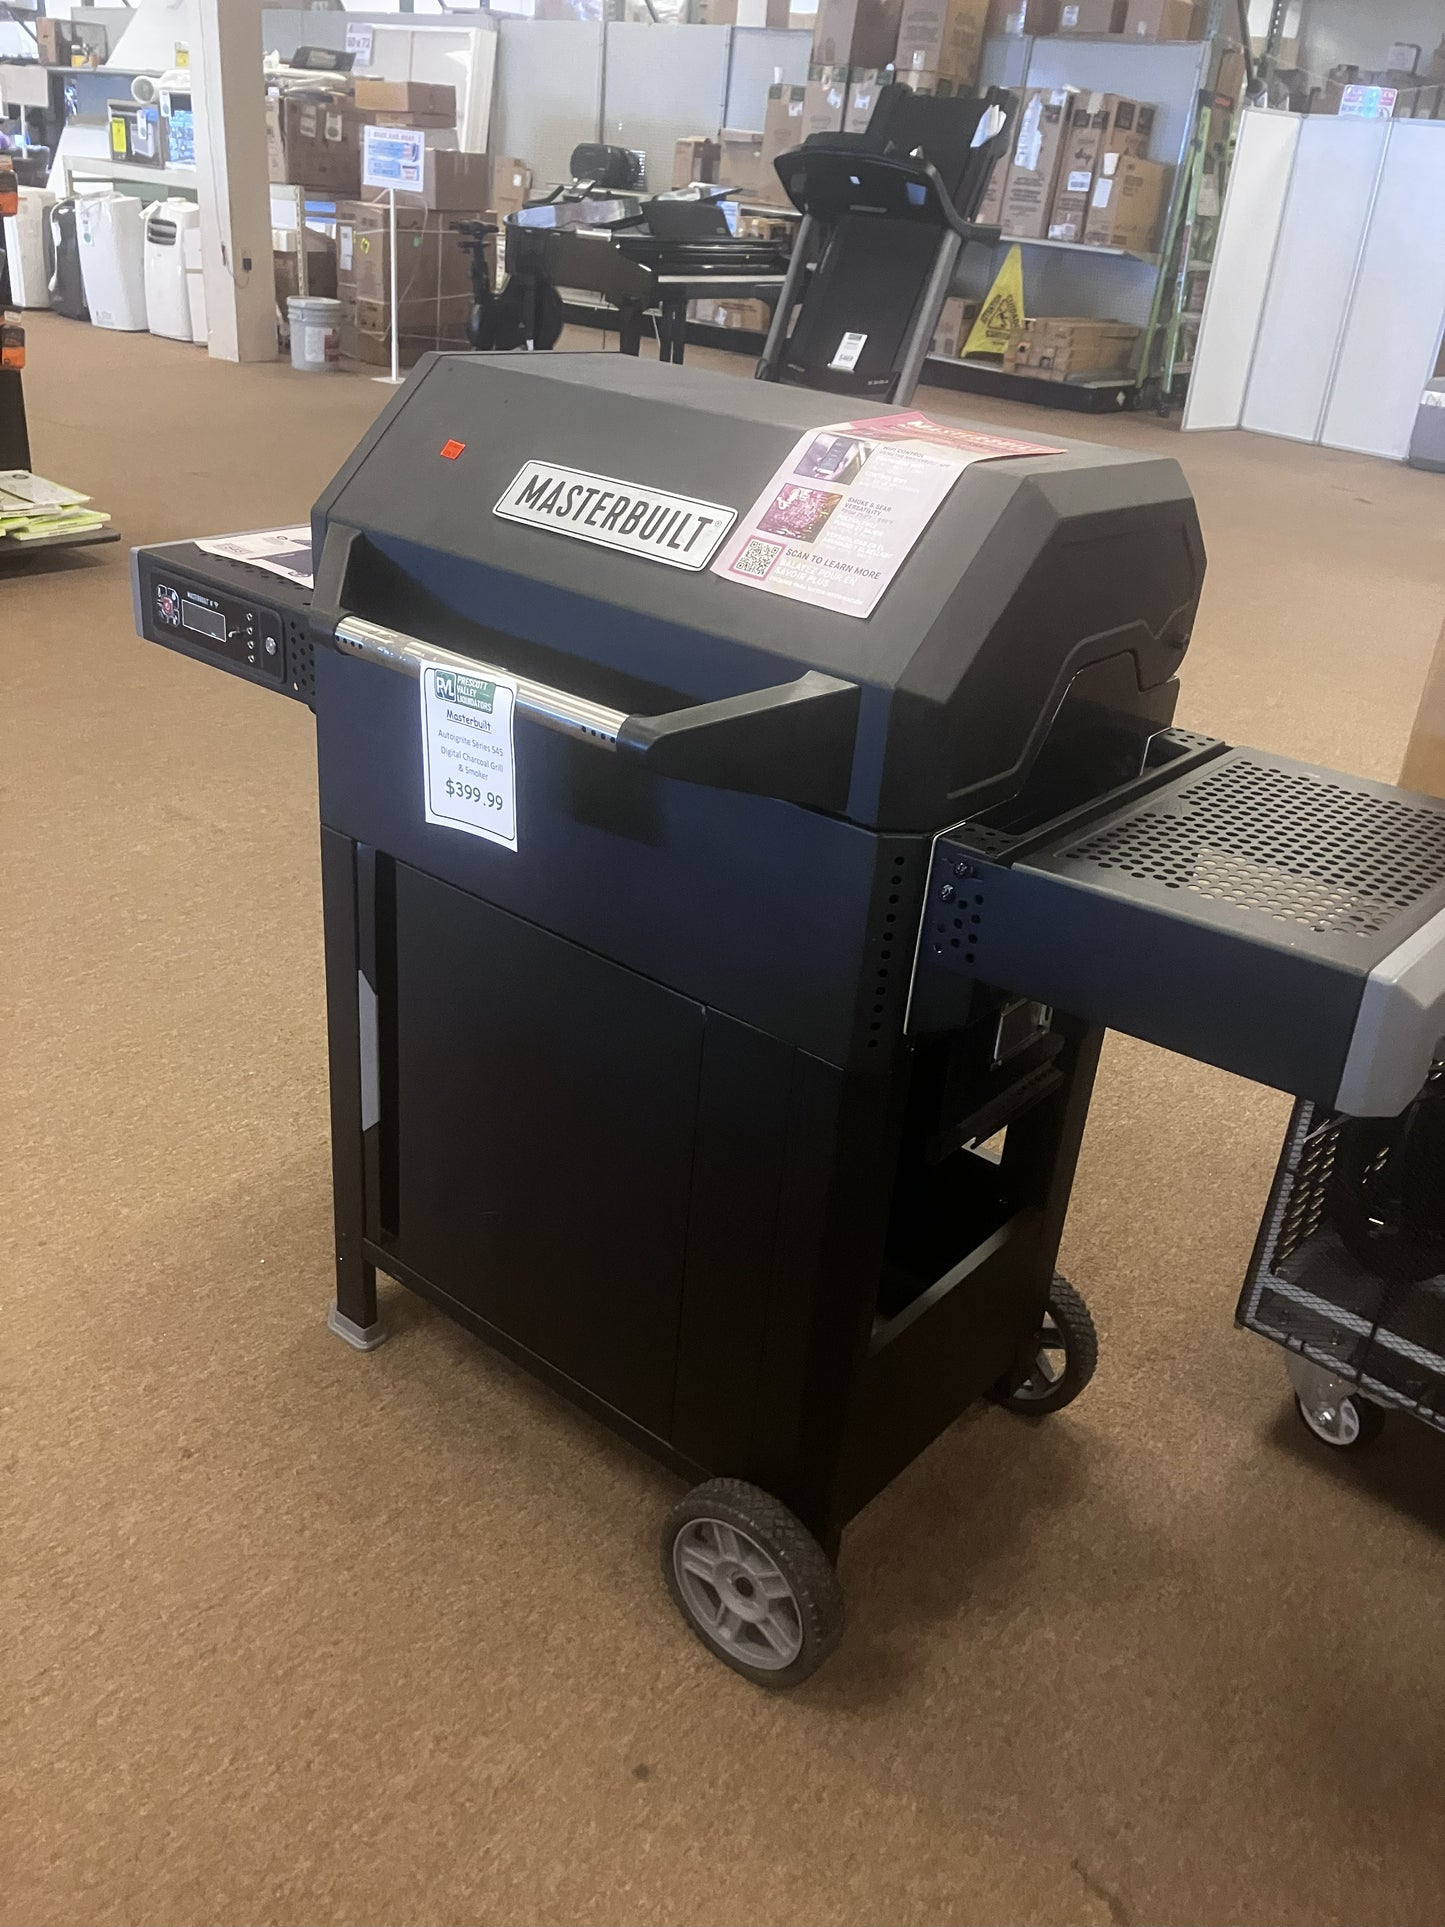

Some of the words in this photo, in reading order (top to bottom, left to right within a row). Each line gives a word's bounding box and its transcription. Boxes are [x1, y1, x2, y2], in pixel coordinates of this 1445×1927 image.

[896, 447, 925, 459] CONTROL
[514, 474, 713, 552] MASTERBUILT
[843, 502, 882, 517] VERSATILITY
[847, 496, 869, 507] SMOKE
[779, 557, 816, 574] BALAYEZ
[817, 567, 843, 583] POUR
[785, 547, 810, 561] SCAN
[811, 554, 823, 564] TO
[823, 558, 853, 573] LEARN
[853, 566, 882, 580] MORE
[774, 566, 806, 581] SAVOIR
[806, 574, 831, 588] PLUS
[436, 676, 455, 701] PVL
[457, 675, 488, 692] PRESCOTT
[457, 684, 477, 698] VALLEY
[456, 694, 492, 713] LIQUIDATORS
[446, 708, 492, 732] Masterbuilt
[437, 729, 471, 747] Autoignite
[471, 738, 491, 754] Series
[491, 745, 504, 757] 545
[440, 745, 462, 760] Digital
[462, 751, 490, 768] Charcoal
[490, 759, 504, 773] Grill
[458, 763, 465, 773] &
[465, 766, 489, 781] Smoker
[445, 776, 504, 811] $399.99
